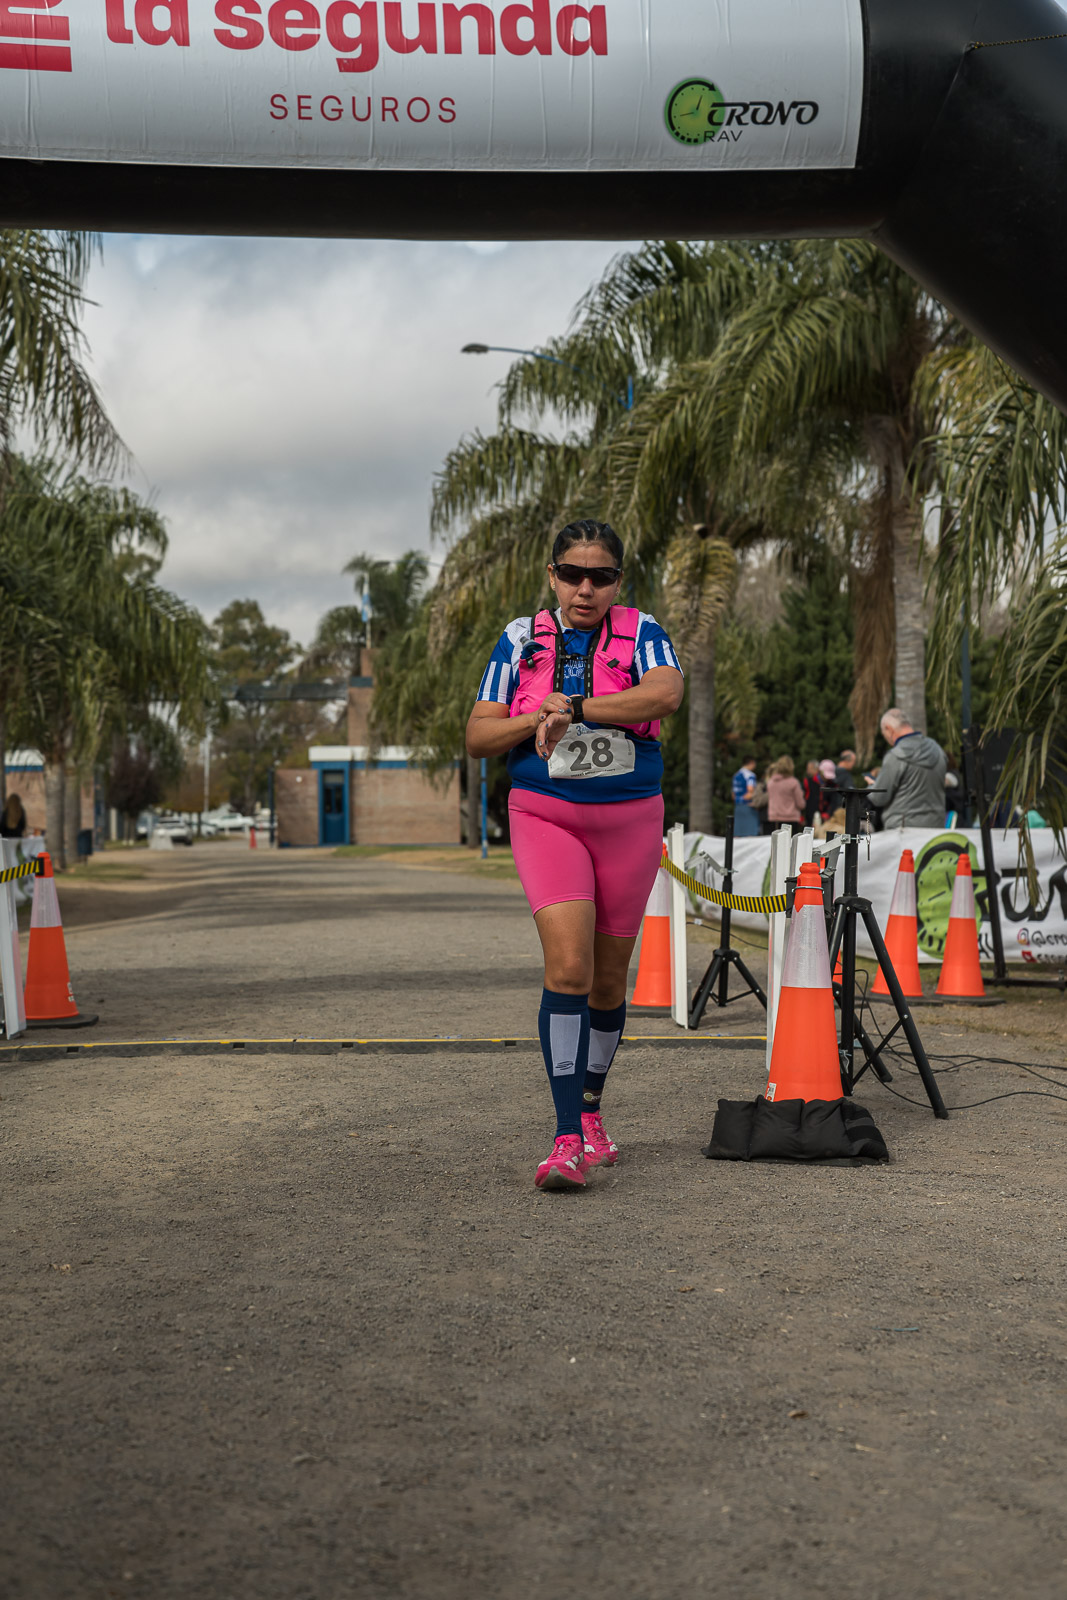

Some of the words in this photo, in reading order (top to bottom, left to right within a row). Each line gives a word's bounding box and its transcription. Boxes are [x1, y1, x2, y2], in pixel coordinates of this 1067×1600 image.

[106, 0, 190, 47] la
[213, 0, 608, 73] segunda
[270, 94, 457, 123] SEGUROS
[707, 101, 819, 126] CRONO
[703, 130, 743, 142] RAV
[567, 737, 614, 771] 28
